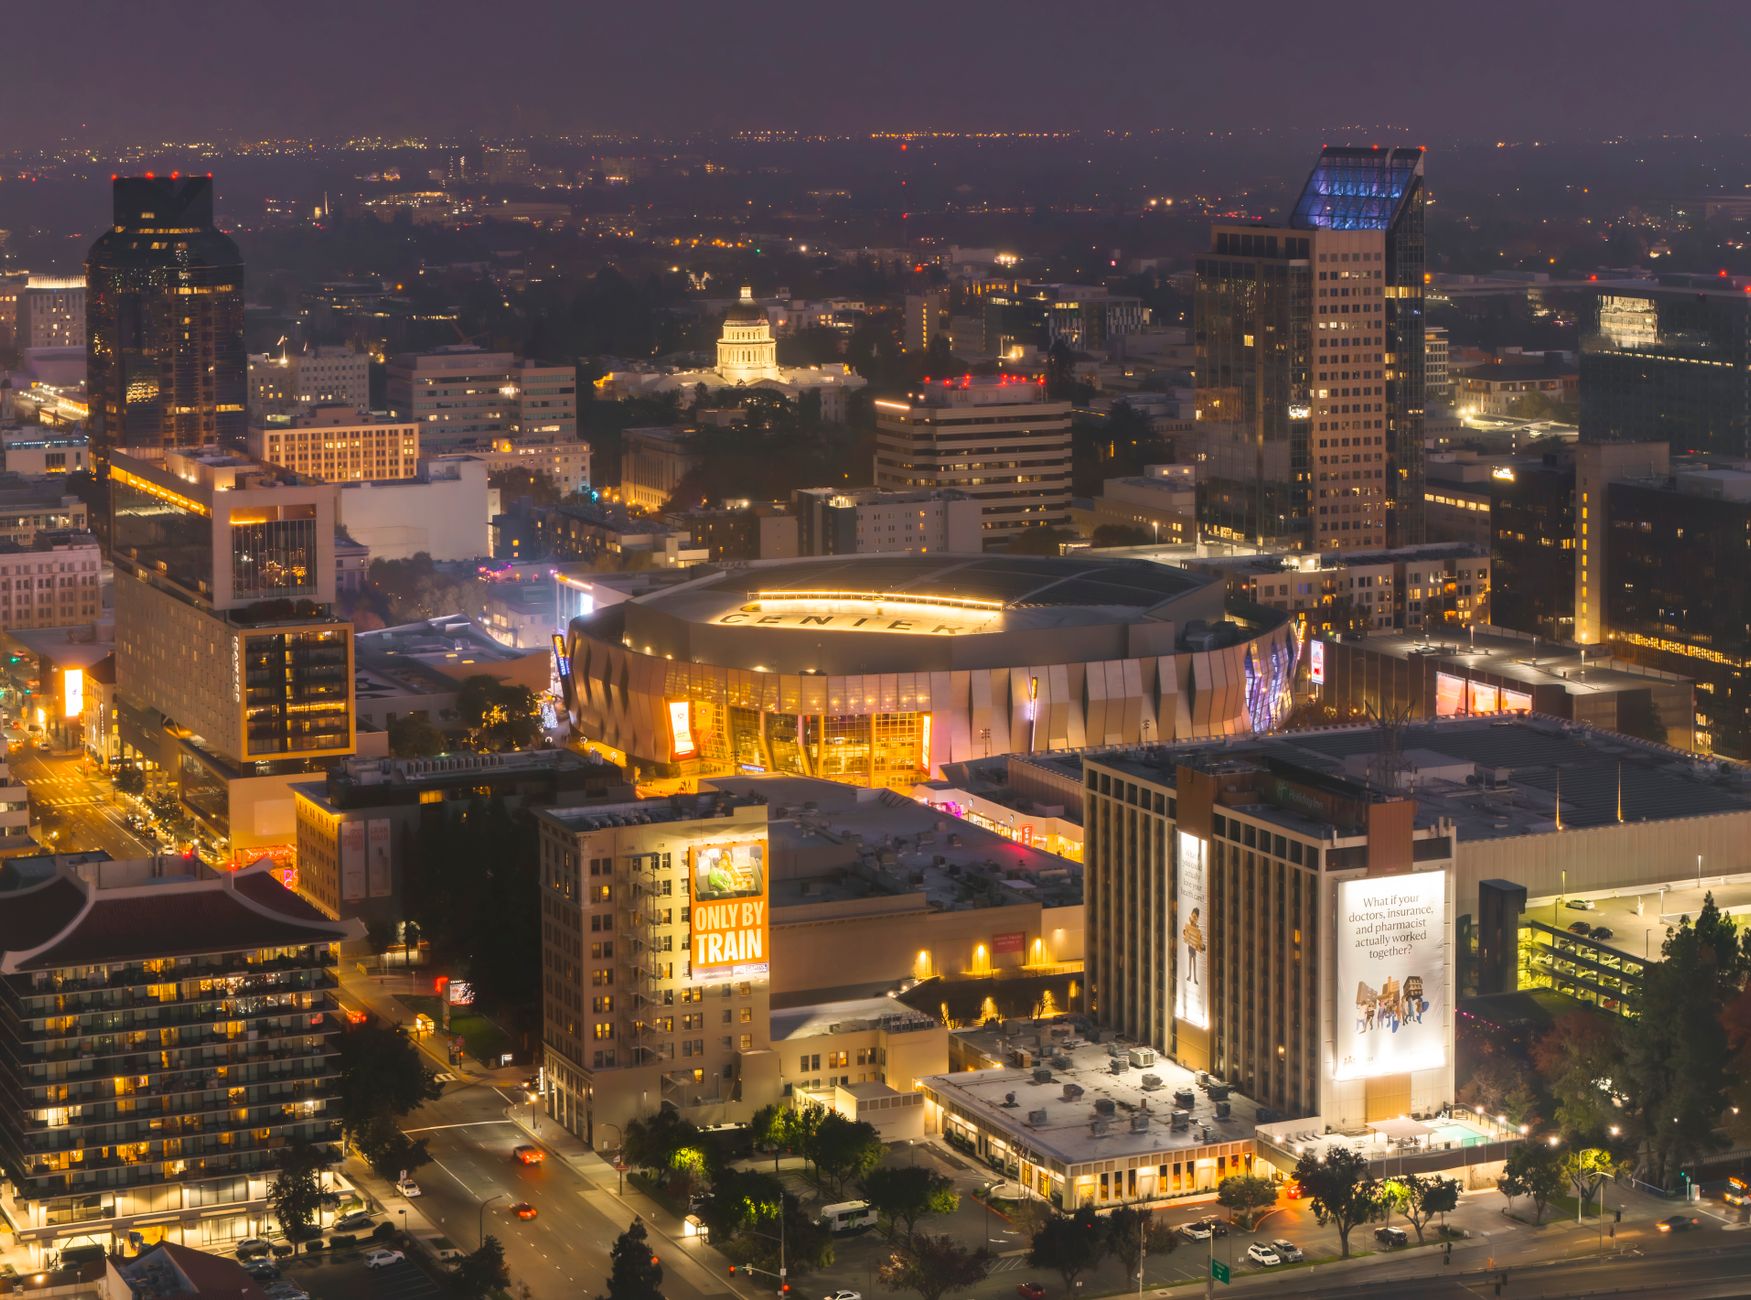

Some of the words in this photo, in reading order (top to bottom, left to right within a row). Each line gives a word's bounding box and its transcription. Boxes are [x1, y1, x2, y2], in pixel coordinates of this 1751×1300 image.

[1363, 896, 1389, 908] What
[1390, 894, 1398, 905] if
[1398, 894, 1419, 907] your
[695, 903, 739, 931] ONLY
[742, 900, 764, 927] BY
[1348, 911, 1386, 923] doctors,
[1387, 905, 1434, 919] insurance,
[1355, 922, 1373, 935] and
[1375, 918, 1426, 935] pharmacist
[695, 928, 762, 965] TRAIN
[1355, 934, 1392, 947] actually
[1391, 929, 1427, 943] worked
[1369, 943, 1413, 960] together?
